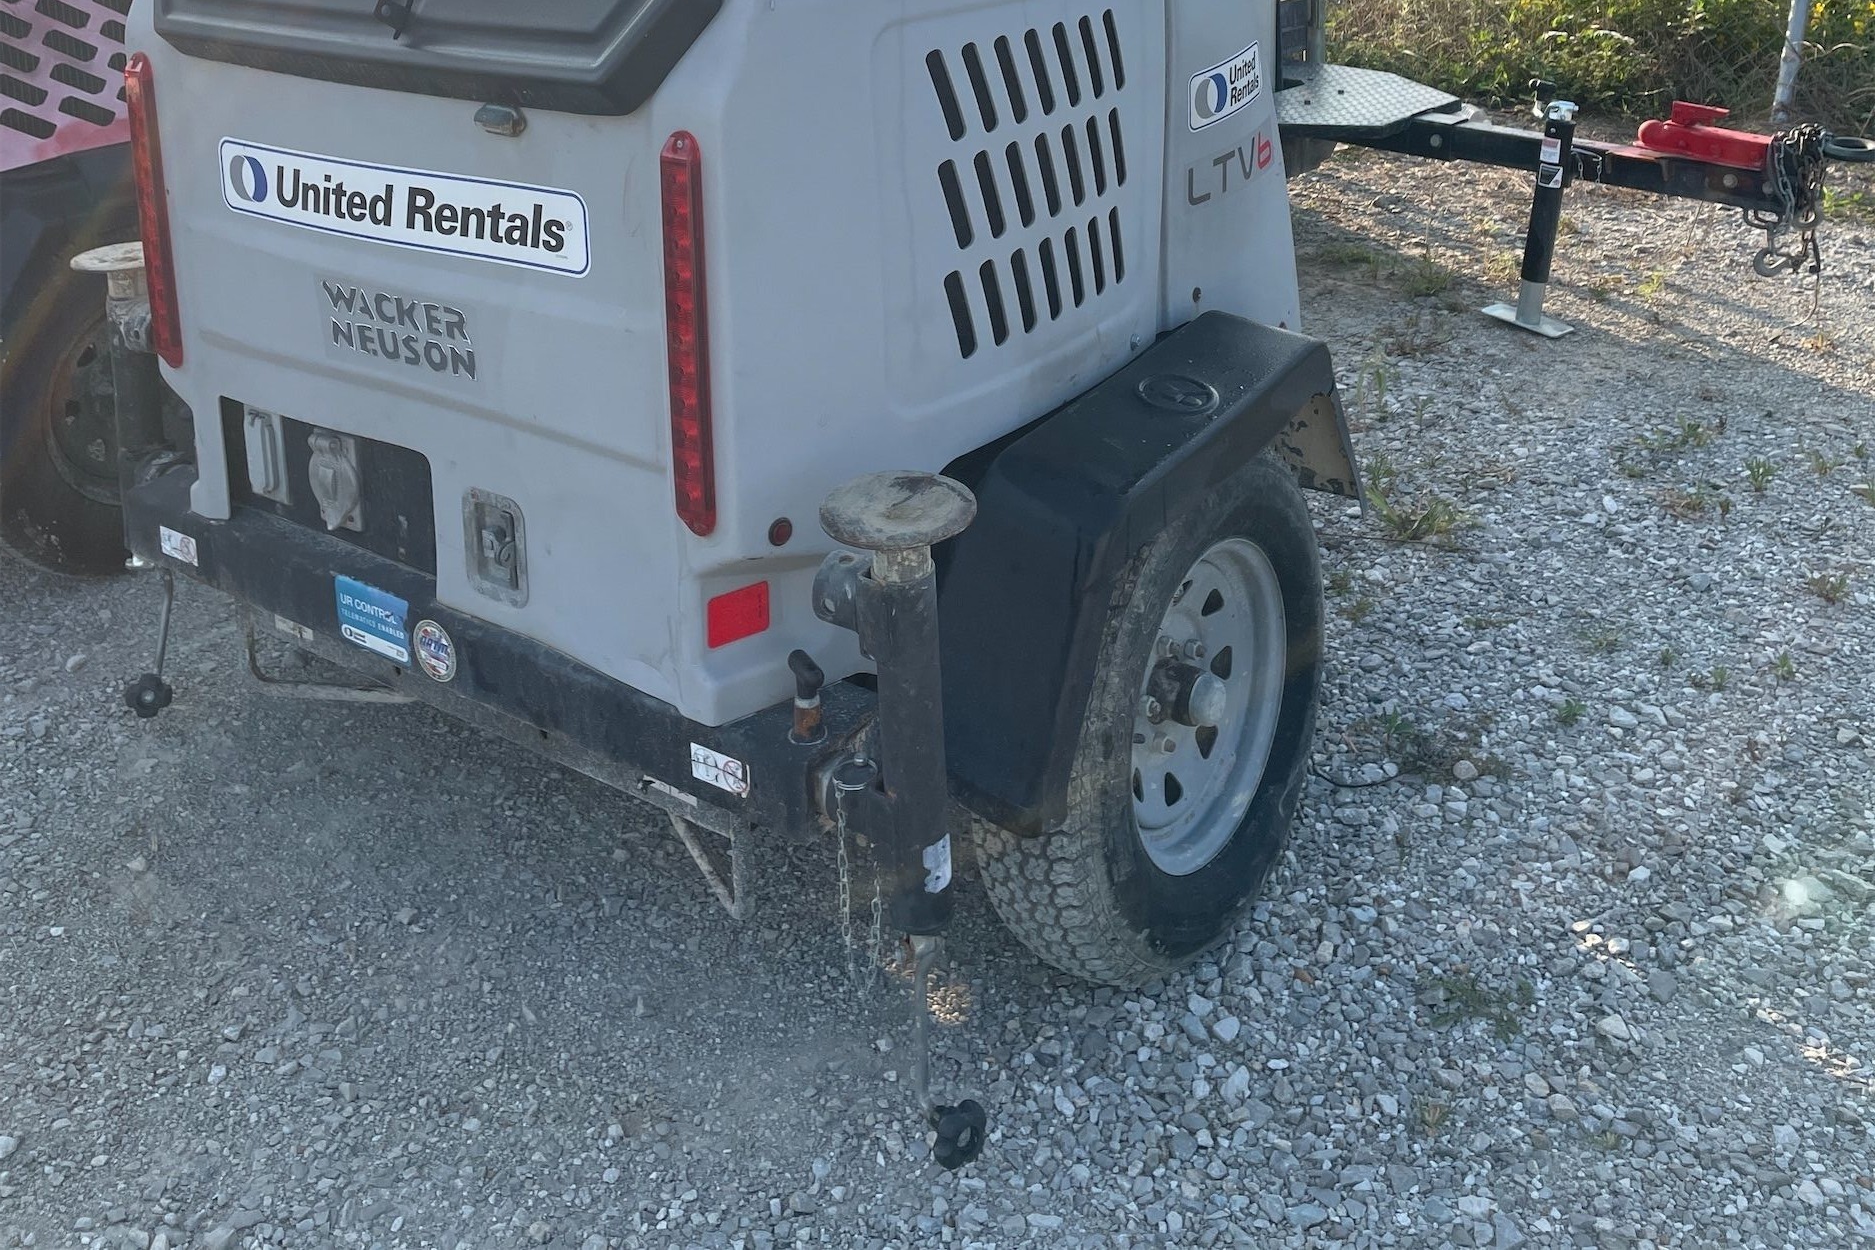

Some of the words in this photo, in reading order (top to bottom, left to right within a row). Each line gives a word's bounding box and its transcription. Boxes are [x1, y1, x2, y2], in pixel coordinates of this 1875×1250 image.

[1229, 51, 1256, 85] United
[1230, 73, 1260, 107] Rentals
[276, 165, 394, 227] United
[322, 278, 472, 344] WACKER
[330, 316, 478, 382] NEUSON
[339, 592, 353, 608] UR
